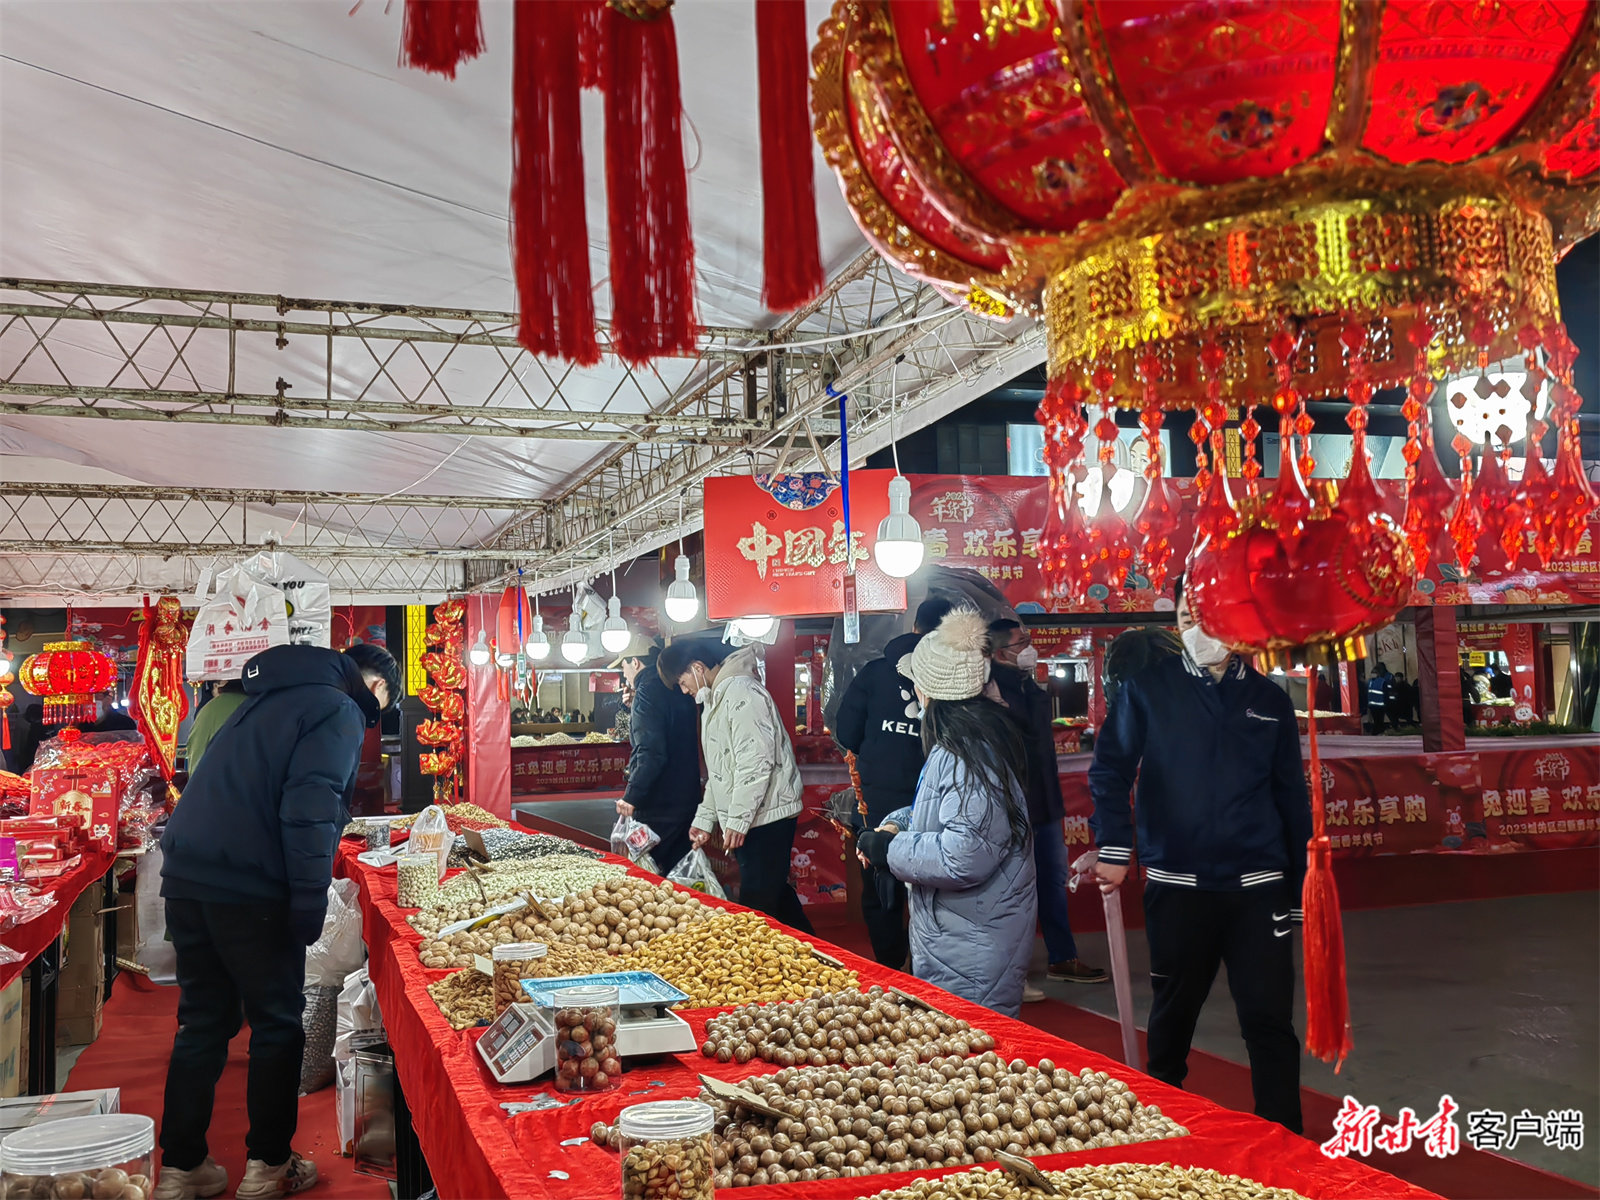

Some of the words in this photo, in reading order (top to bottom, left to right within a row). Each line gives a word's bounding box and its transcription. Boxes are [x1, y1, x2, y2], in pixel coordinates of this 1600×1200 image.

[929, 495, 975, 524] 年货节
[282, 580, 305, 590] YOU
[881, 719, 919, 737] KEL
[1325, 795, 1427, 826] 欢乐享购
